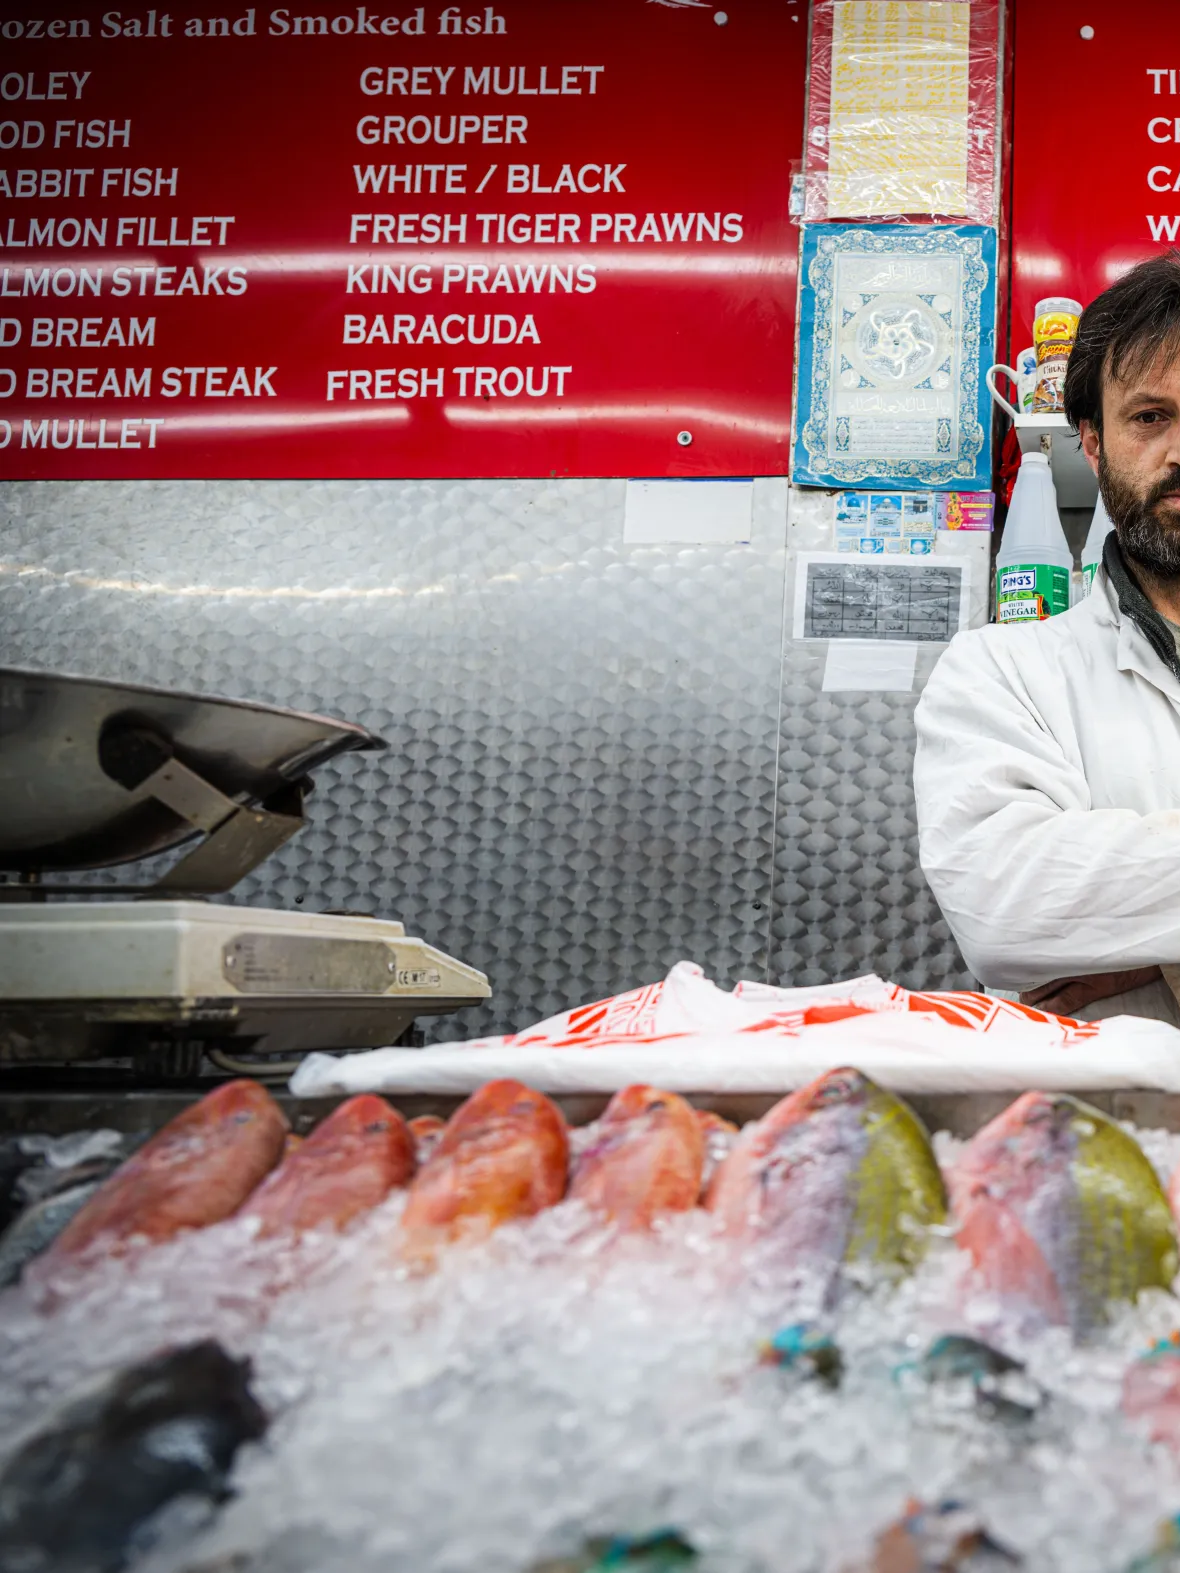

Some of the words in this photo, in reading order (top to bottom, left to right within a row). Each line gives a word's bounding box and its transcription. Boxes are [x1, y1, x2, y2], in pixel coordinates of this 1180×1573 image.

[0, 18, 91, 39] ozen
[101, 10, 173, 38] Salt
[184, 8, 256, 37] and
[268, 8, 426, 37] Smoked
[438, 7, 508, 36] fish
[0, 72, 92, 100] OLEY
[359, 67, 455, 95] GREY
[463, 66, 605, 95] MULLET
[0, 120, 45, 149] OD
[54, 119, 131, 148] FISH
[356, 115, 528, 145] GROUPER
[0, 169, 94, 198] ABBIT
[101, 167, 178, 197] FISH
[353, 164, 467, 194] WHITE
[475, 164, 498, 194] /
[507, 164, 627, 194] BLACK
[0, 218, 108, 247] LMON
[116, 216, 235, 247] FILLET
[349, 213, 467, 243] FRESH
[476, 213, 580, 243] TIGER
[590, 212, 743, 243] PRAWNS
[0, 268, 102, 297] LMON
[111, 266, 248, 296] STEAKS
[345, 264, 433, 294] KING
[442, 263, 597, 294] PRAWNS
[31, 317, 156, 347] BREAM
[342, 314, 541, 345] BARACUDA
[26, 368, 152, 398] BREAM
[160, 367, 278, 397] STEAK
[326, 368, 444, 401] FRESH
[453, 366, 572, 397] TROUT
[21, 418, 164, 449] MULLET
[1000, 607, 1037, 618] VINEGAR
